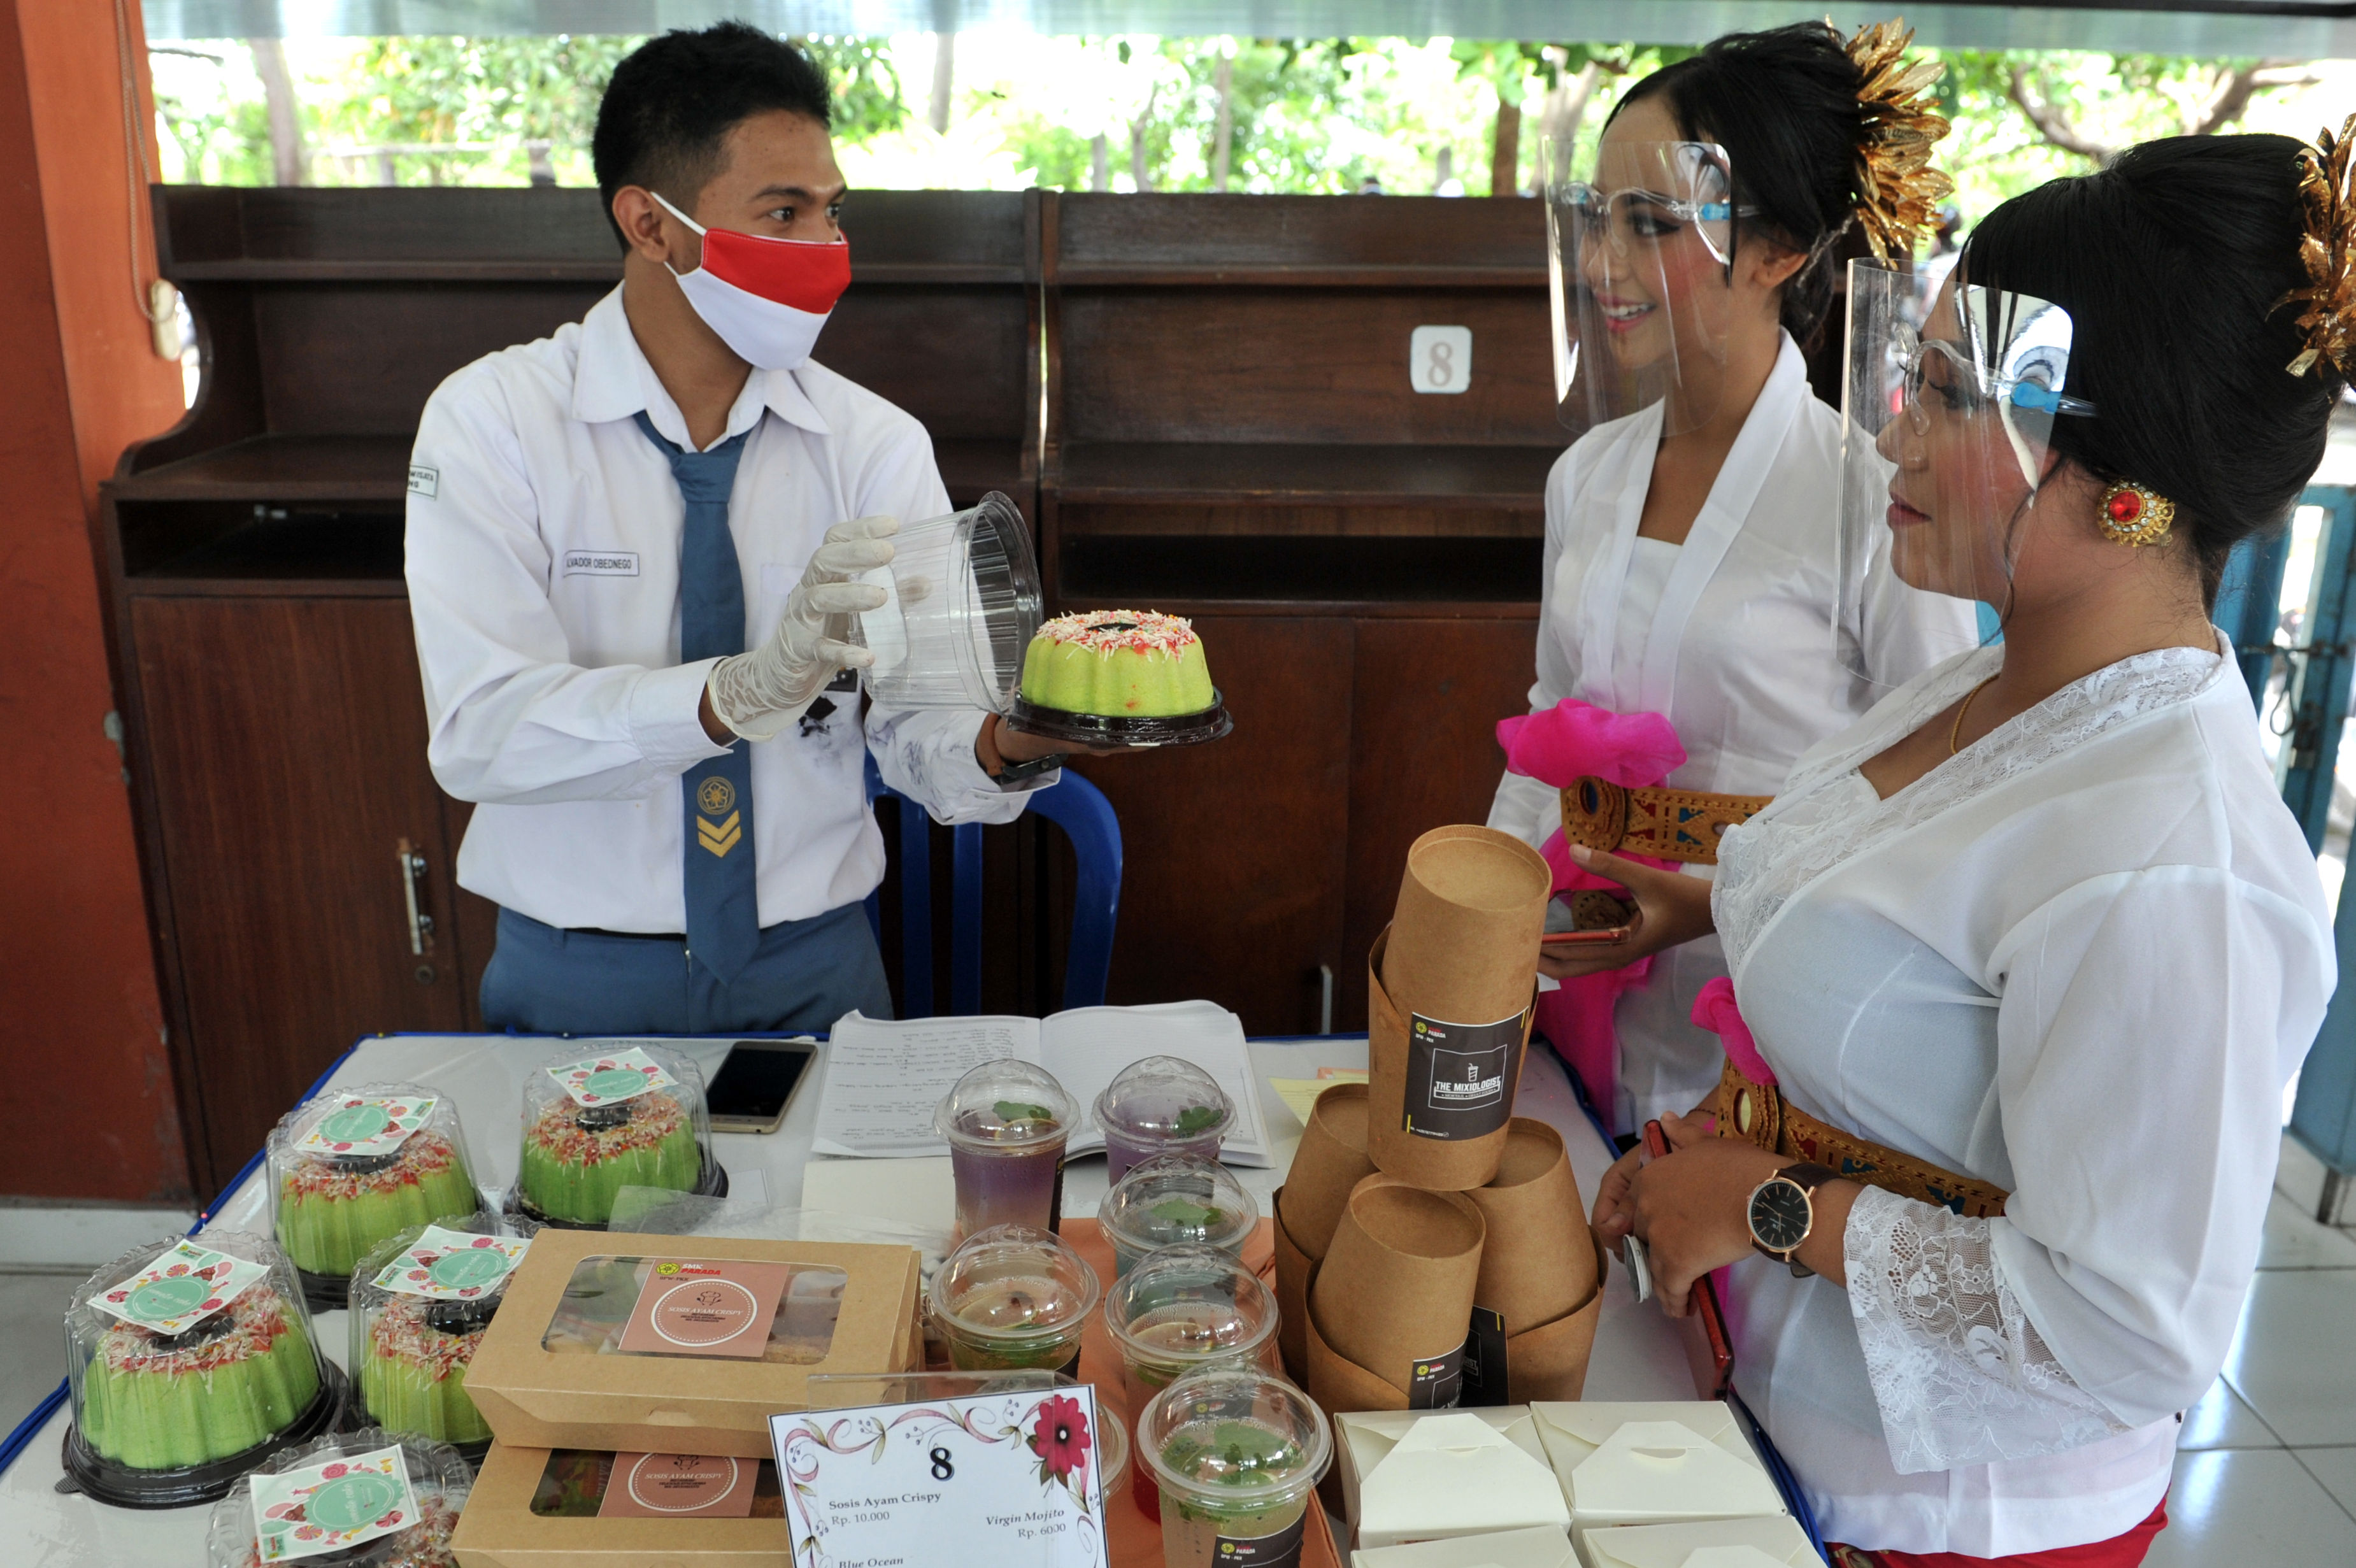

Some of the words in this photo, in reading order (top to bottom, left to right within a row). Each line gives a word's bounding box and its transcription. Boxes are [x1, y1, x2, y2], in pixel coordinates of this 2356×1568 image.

[1427, 341, 1453, 387] 8
[593, 559, 632, 569] OBEDNEGO
[1436, 1081, 1452, 1091] THE
[1453, 1076, 1501, 1092] MIXIOLOGIST
[929, 1446, 955, 1481] 8
[829, 1499, 860, 1510] Sosis
[864, 1497, 898, 1509] Ayam
[901, 1493, 941, 1503] Crispy
[831, 1516, 850, 1527] Rp.
[855, 1511, 890, 1523] 10.000
[986, 1515, 1021, 1527] Virgin
[1024, 1509, 1064, 1522] Mojito
[1018, 1529, 1037, 1539] Rp.
[1040, 1523, 1066, 1535] 6000
[839, 1560, 864, 1568] Blue
[867, 1557, 904, 1566] Ocean
